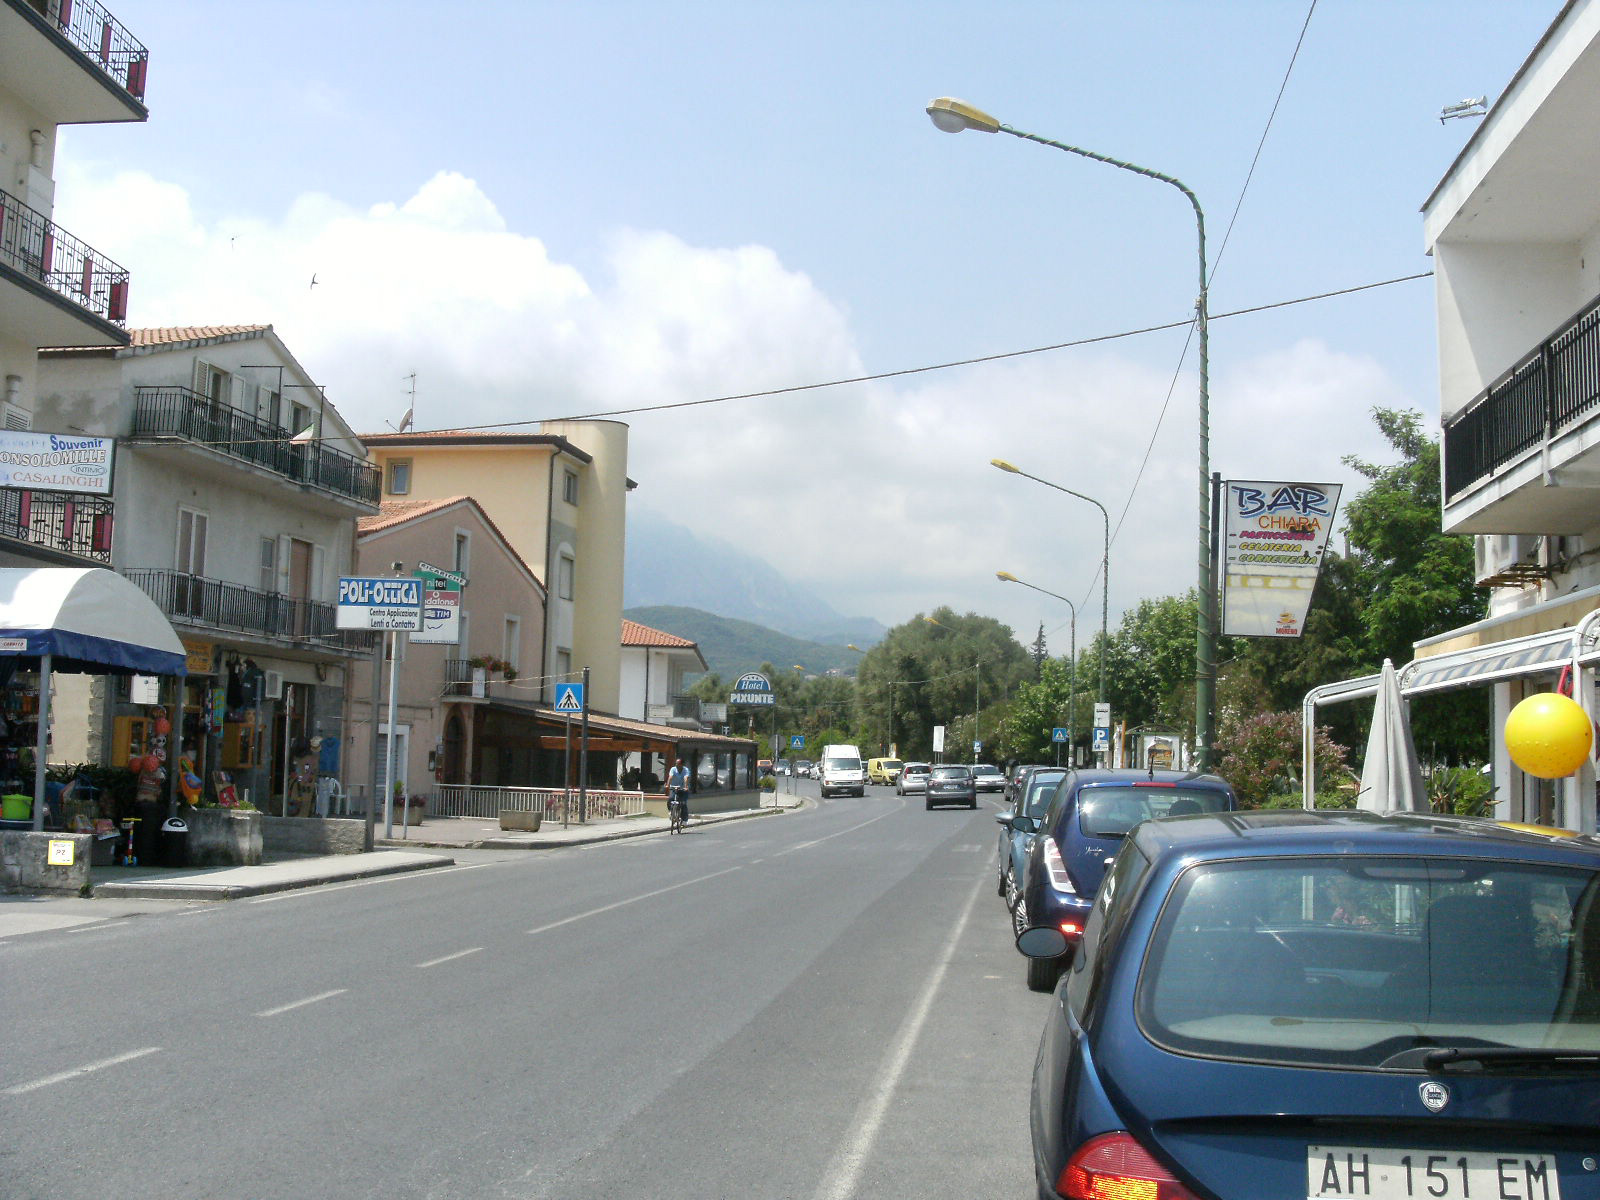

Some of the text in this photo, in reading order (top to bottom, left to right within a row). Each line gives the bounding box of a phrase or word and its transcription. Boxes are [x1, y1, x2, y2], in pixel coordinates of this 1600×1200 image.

[50, 434, 103, 451] Souvenir
[75, 466, 103, 474] INTIMO
[13, 471, 104, 487] CASALINGHI
[1231, 485, 1330, 518] BAR
[1258, 515, 1322, 531] CHIARA
[1239, 530, 1316, 541] PASTICCERIA
[1239, 541, 1303, 552] GELATERIA
[1238, 553, 1318, 565] CORNETTERIA
[369, 607, 418, 618] Centro Applicazione
[437, 610, 450, 618] TIM
[371, 619, 386, 628] Lenti
[391, 620, 416, 629] Contatto
[741, 680, 764, 690] Hotel
[730, 693, 774, 704] PIXUNTE
[1320, 1152, 1551, 1200] AH 151 EM
